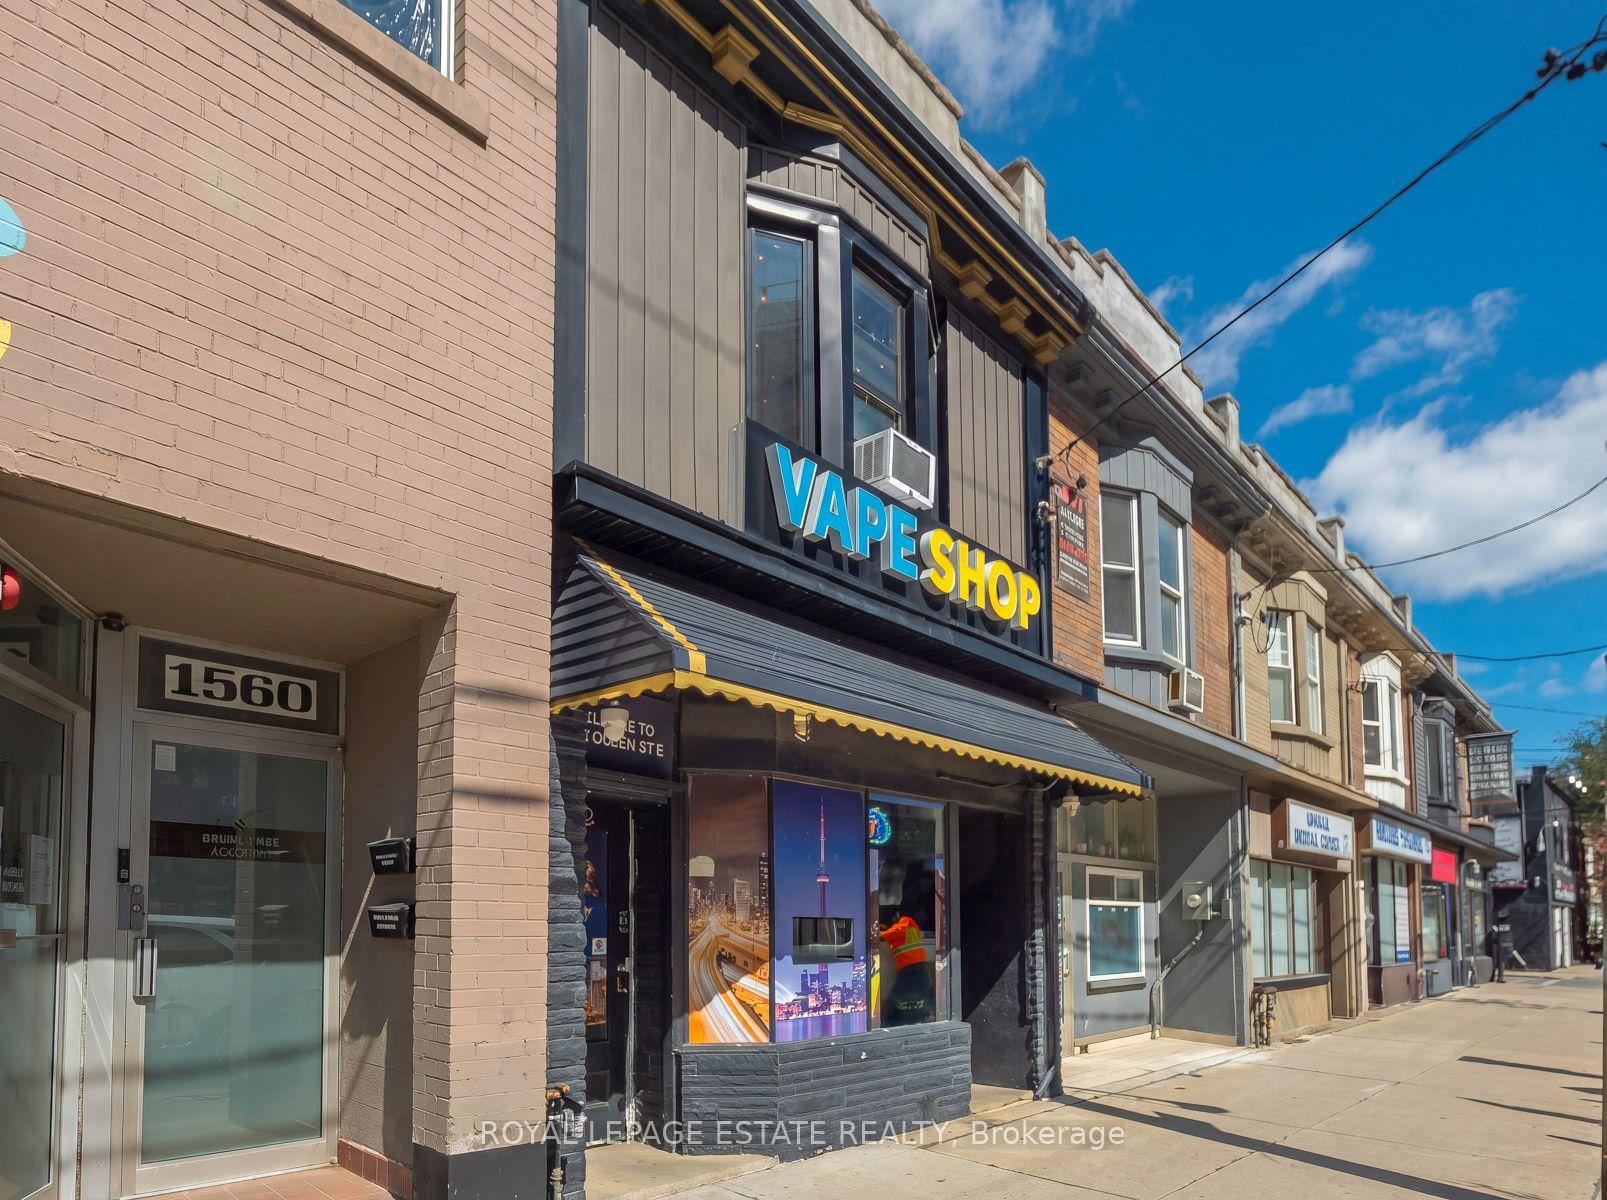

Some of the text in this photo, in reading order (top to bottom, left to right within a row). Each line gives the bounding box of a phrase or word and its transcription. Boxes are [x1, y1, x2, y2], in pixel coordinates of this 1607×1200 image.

[766, 443, 1041, 630] VAPE SHOP
[169, 663, 312, 713] 1560
[638, 721, 655, 737] TO
